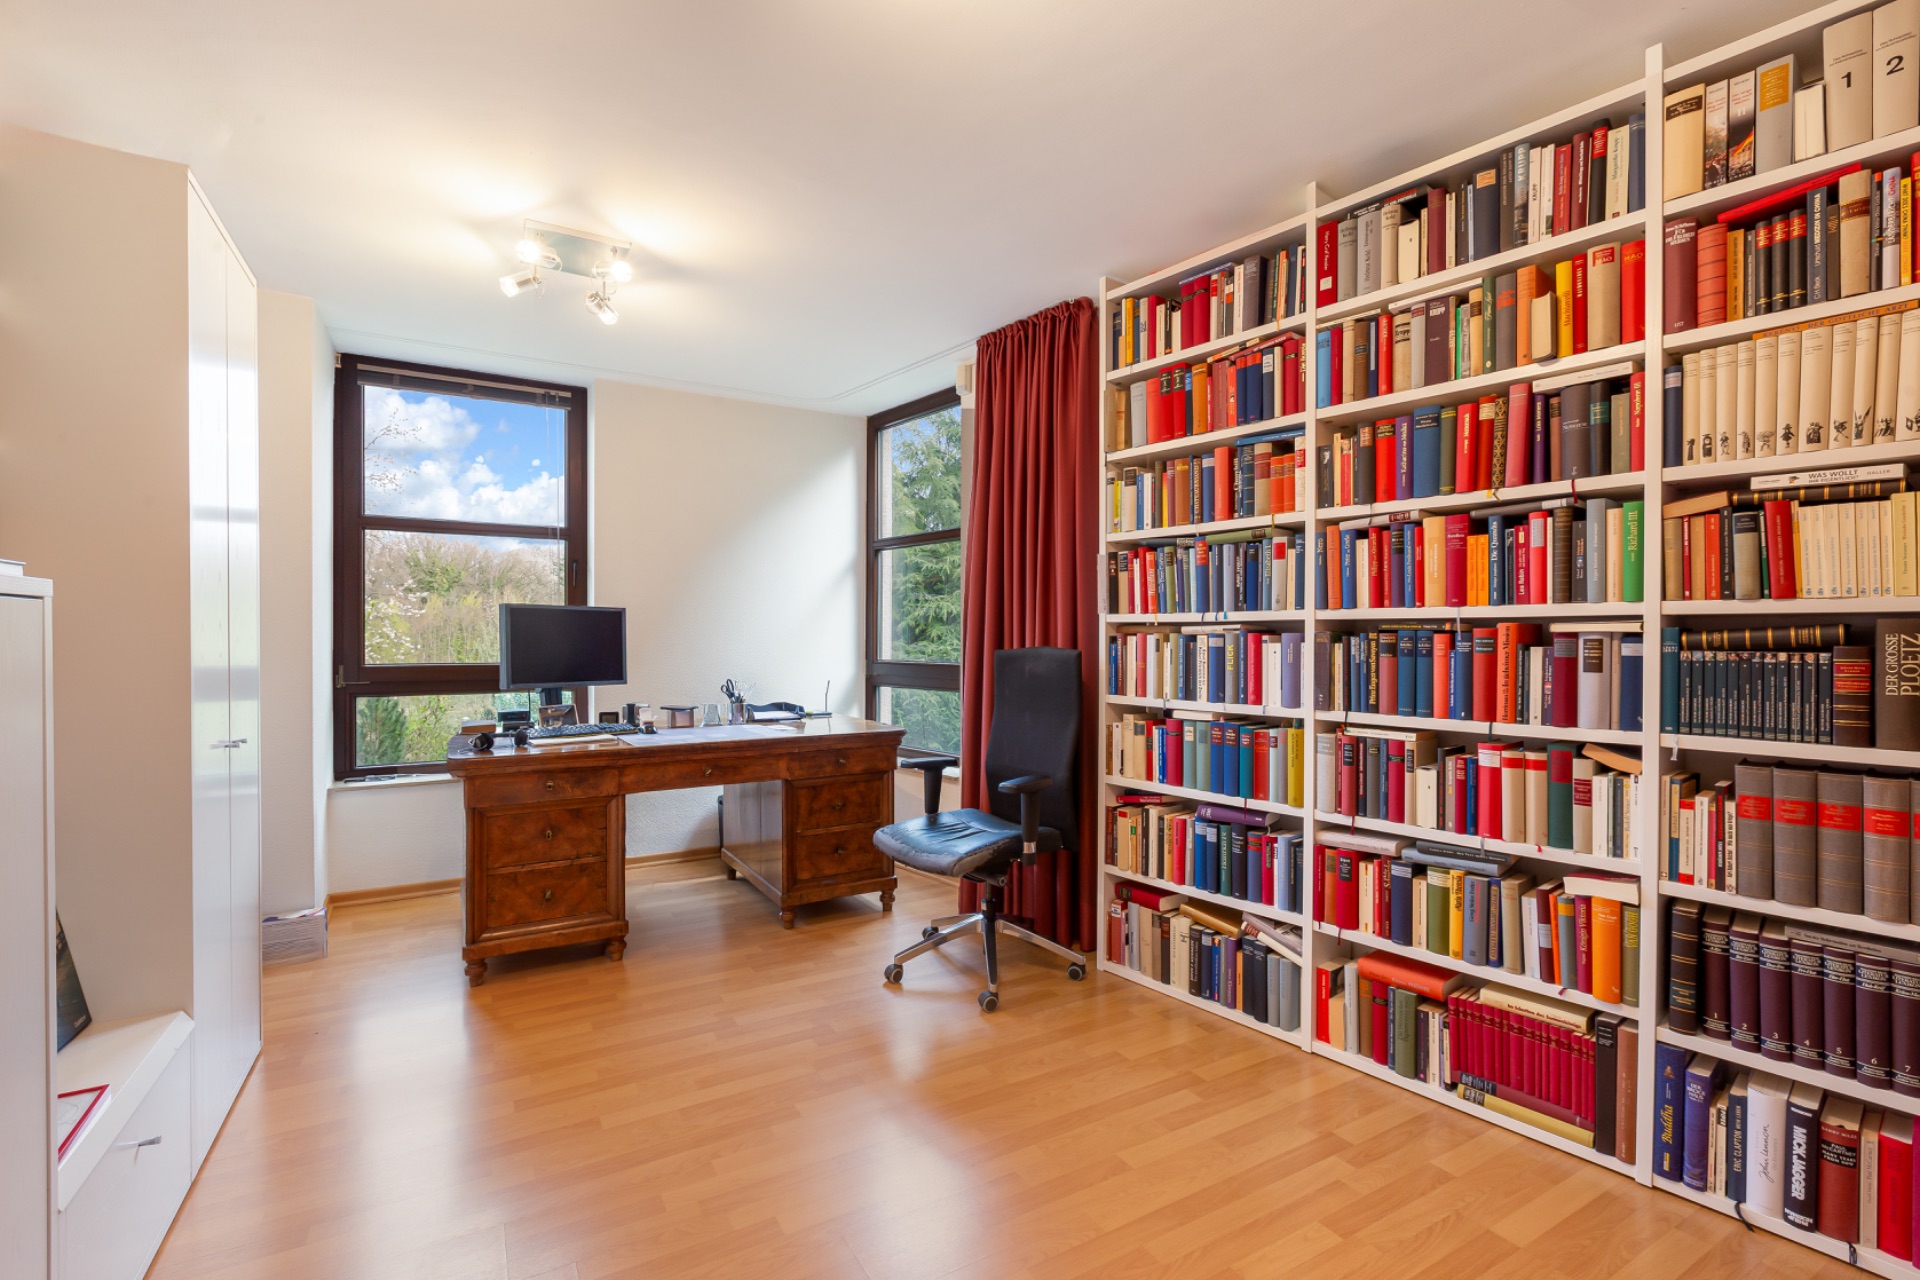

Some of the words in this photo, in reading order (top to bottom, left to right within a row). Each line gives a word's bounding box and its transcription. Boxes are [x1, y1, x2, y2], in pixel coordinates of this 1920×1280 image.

[1886, 55, 1905, 77] 2
[1841, 71, 1852, 89] 1
[1517, 147, 1527, 182] KRUPP
[1829, 469, 1858, 478] WOLLT
[1490, 521, 1498, 548] Quandts
[1627, 522, 1637, 551] Richard
[1502, 626, 1510, 650] Mission
[1369, 640, 1377, 663] Savoyen
[1885, 632, 1898, 672] GROSSE
[1900, 632, 1919, 696] PLOETZ
[1369, 672, 1377, 690] Eugen
[1885, 674, 1898, 696] DER
[1579, 903, 1587, 927] Viktoria
[1628, 912, 1638, 933] GOGH
[1579, 928, 1589, 952] Königin
[1628, 935, 1639, 948] VAN
[1904, 1065, 1911, 1073] 7
[1659, 1104, 1674, 1145] Buddha
[1733, 1130, 1742, 1157] CLAPTON
[1760, 1124, 1769, 1158] Lennon
[1792, 1125, 1807, 1156] MICK
[1733, 1159, 1742, 1172] ERIC
[1791, 1155, 1807, 1200] JAGGER
